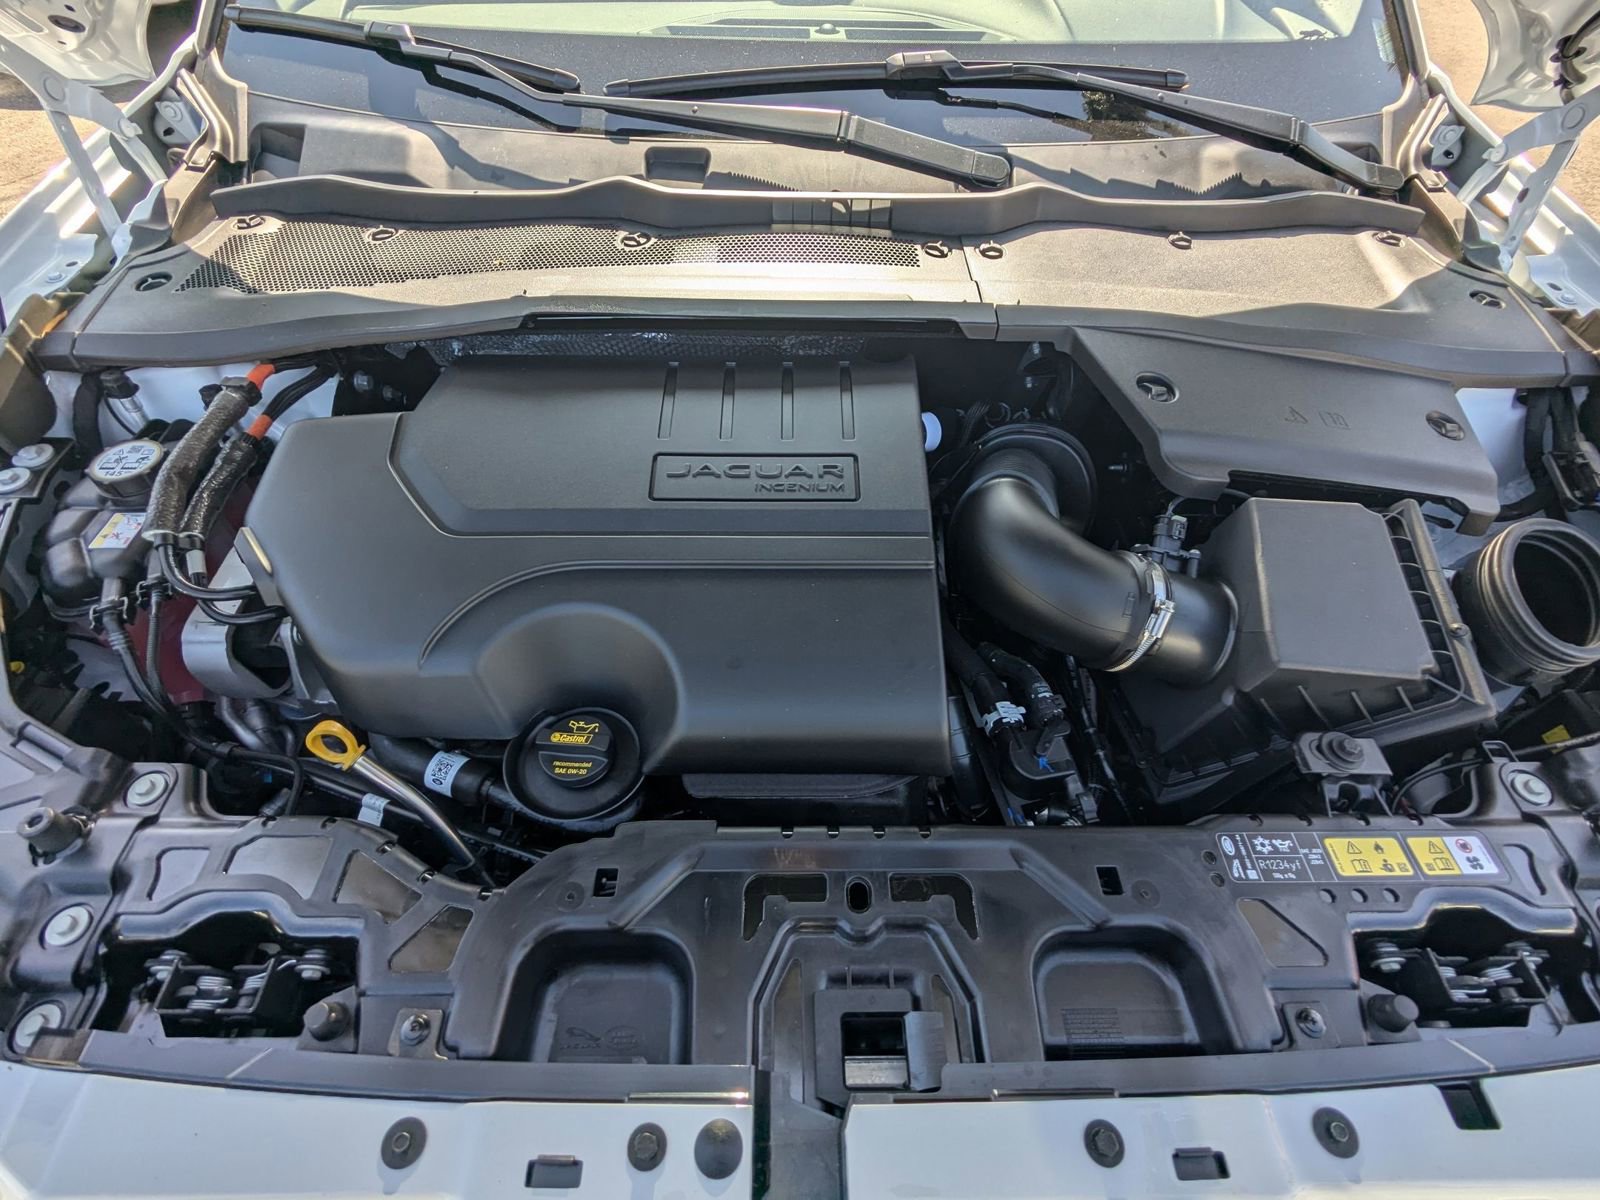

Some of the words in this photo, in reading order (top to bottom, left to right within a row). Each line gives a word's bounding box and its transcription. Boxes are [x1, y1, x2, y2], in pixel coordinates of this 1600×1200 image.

[666, 462, 845, 479] JAGUAR
[754, 482, 846, 494] INGENIUM
[560, 733, 588, 743] Castrol
